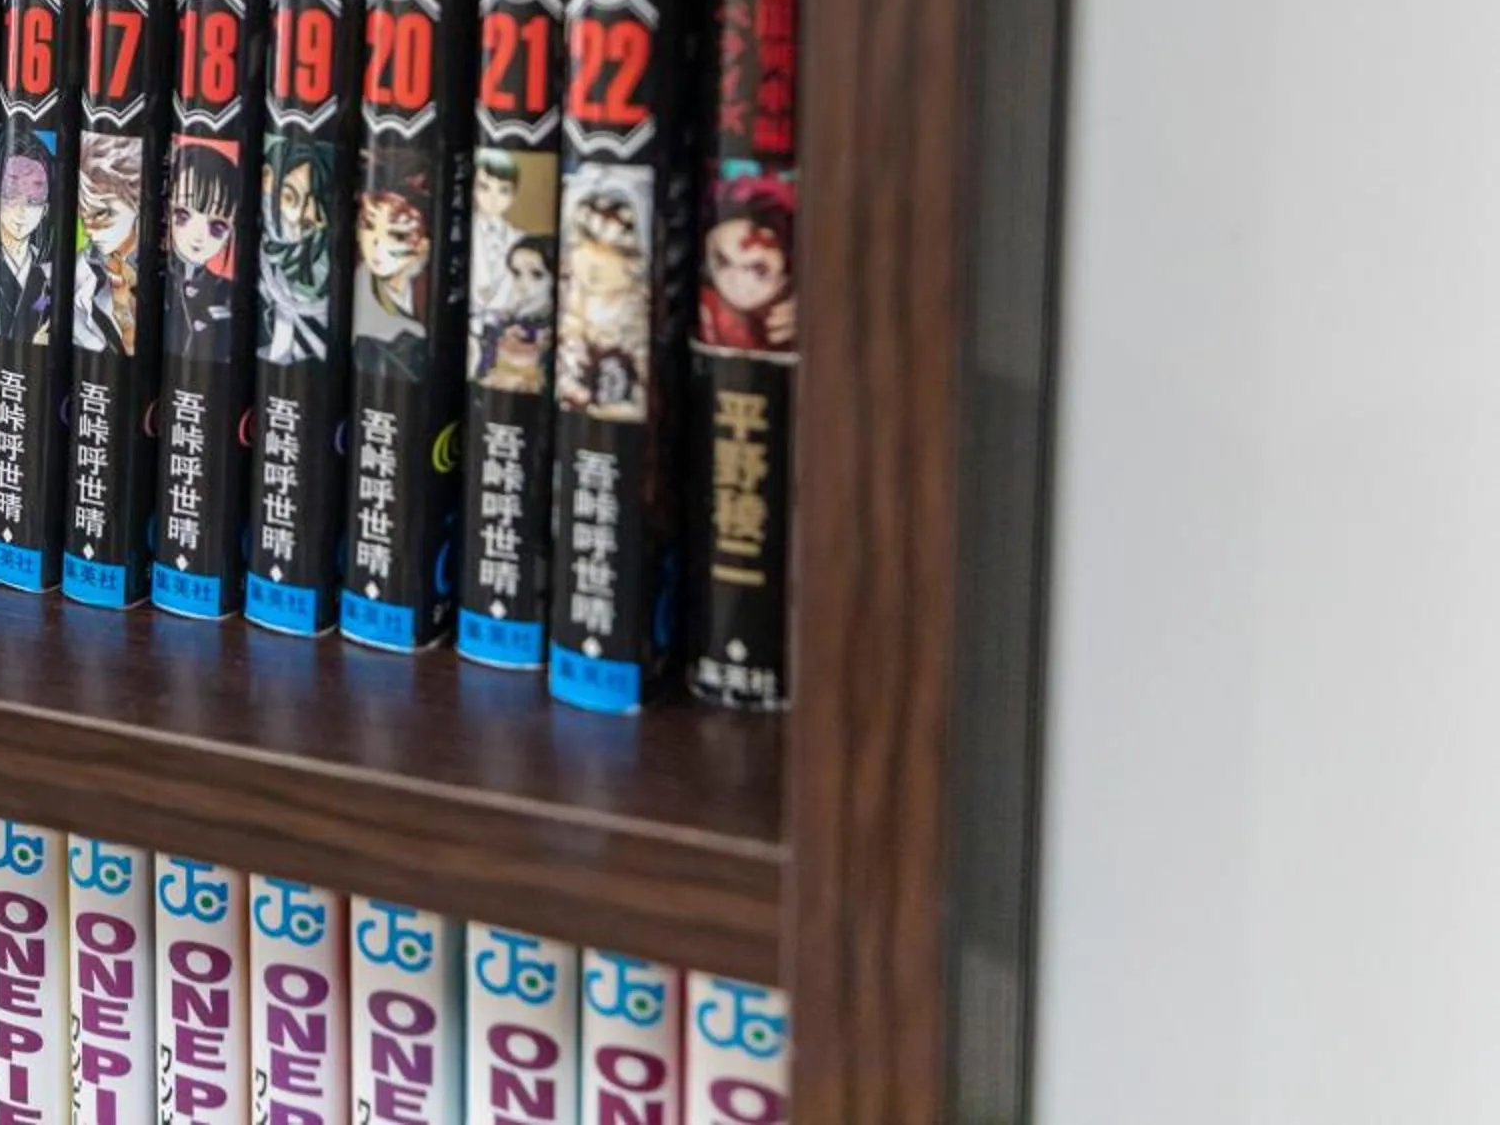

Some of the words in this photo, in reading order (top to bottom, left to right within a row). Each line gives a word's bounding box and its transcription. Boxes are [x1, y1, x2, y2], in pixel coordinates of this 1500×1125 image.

[3, 7, 55, 94] 16
[86, 12, 143, 100] 17
[179, 12, 238, 103] 18
[273, 9, 334, 104] 19
[363, 11, 434, 105] 20
[480, 13, 550, 112] 21
[568, 18, 651, 125] 22
[74, 381, 110, 539] 吾峠呼世晴
[167, 390, 207, 549] 吾峠呼世晴
[261, 395, 301, 561] 吾峠呼世晴
[356, 408, 397, 576] 吾峠呼世晴
[75, 912, 136, 1041] ONE
[169, 940, 233, 1072] ONE
[263, 963, 329, 1097] ONE
